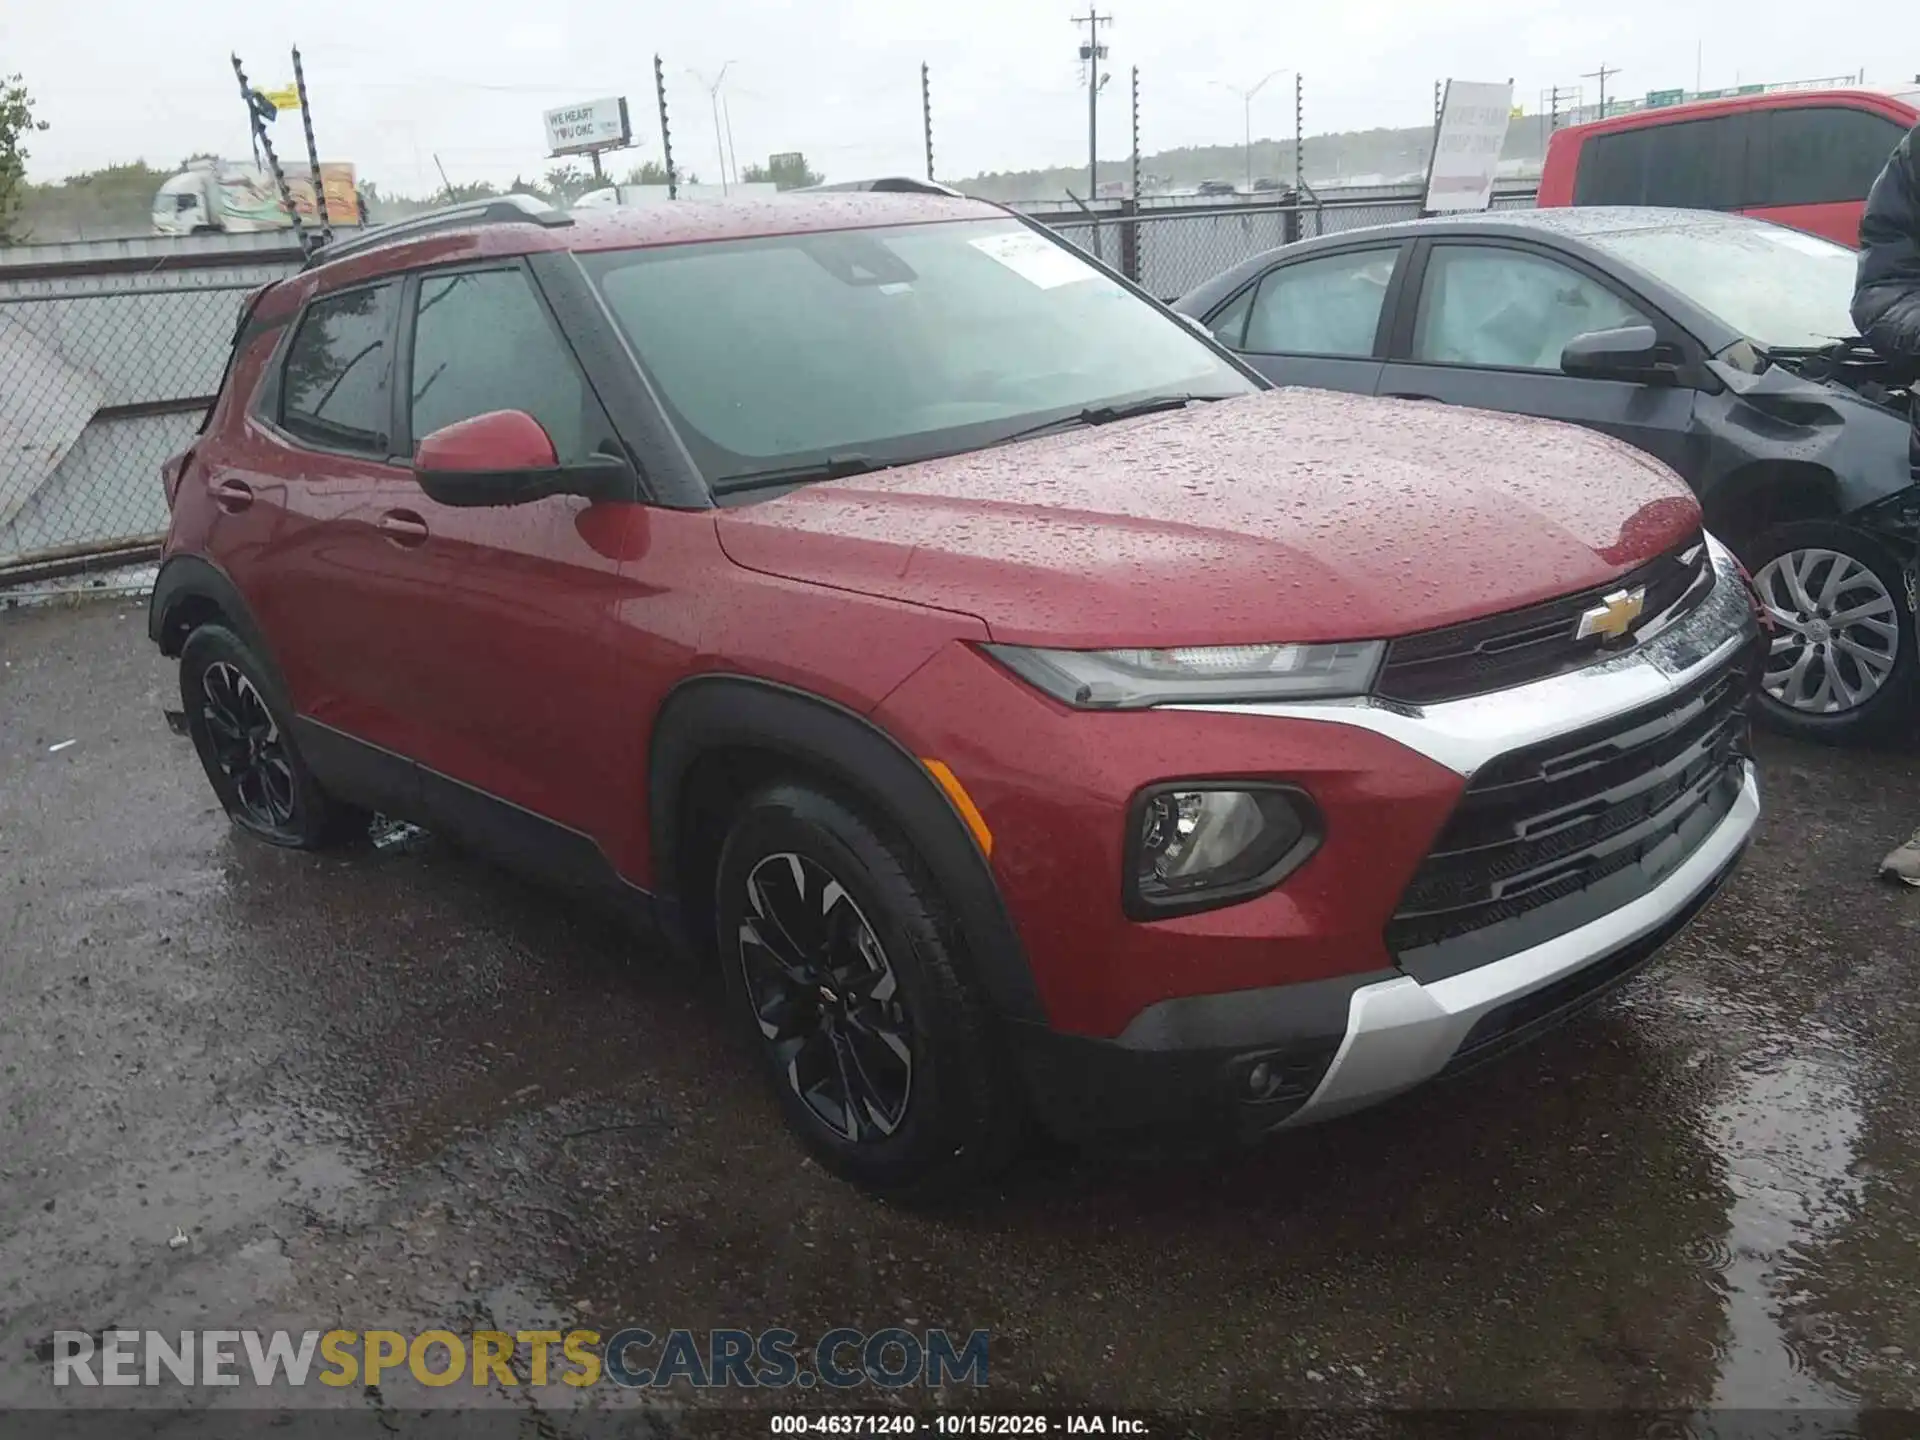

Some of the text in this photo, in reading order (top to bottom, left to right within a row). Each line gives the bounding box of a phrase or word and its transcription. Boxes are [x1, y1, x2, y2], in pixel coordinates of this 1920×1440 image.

[549, 108, 593, 126] WE HEART
[575, 123, 594, 137] OKC
